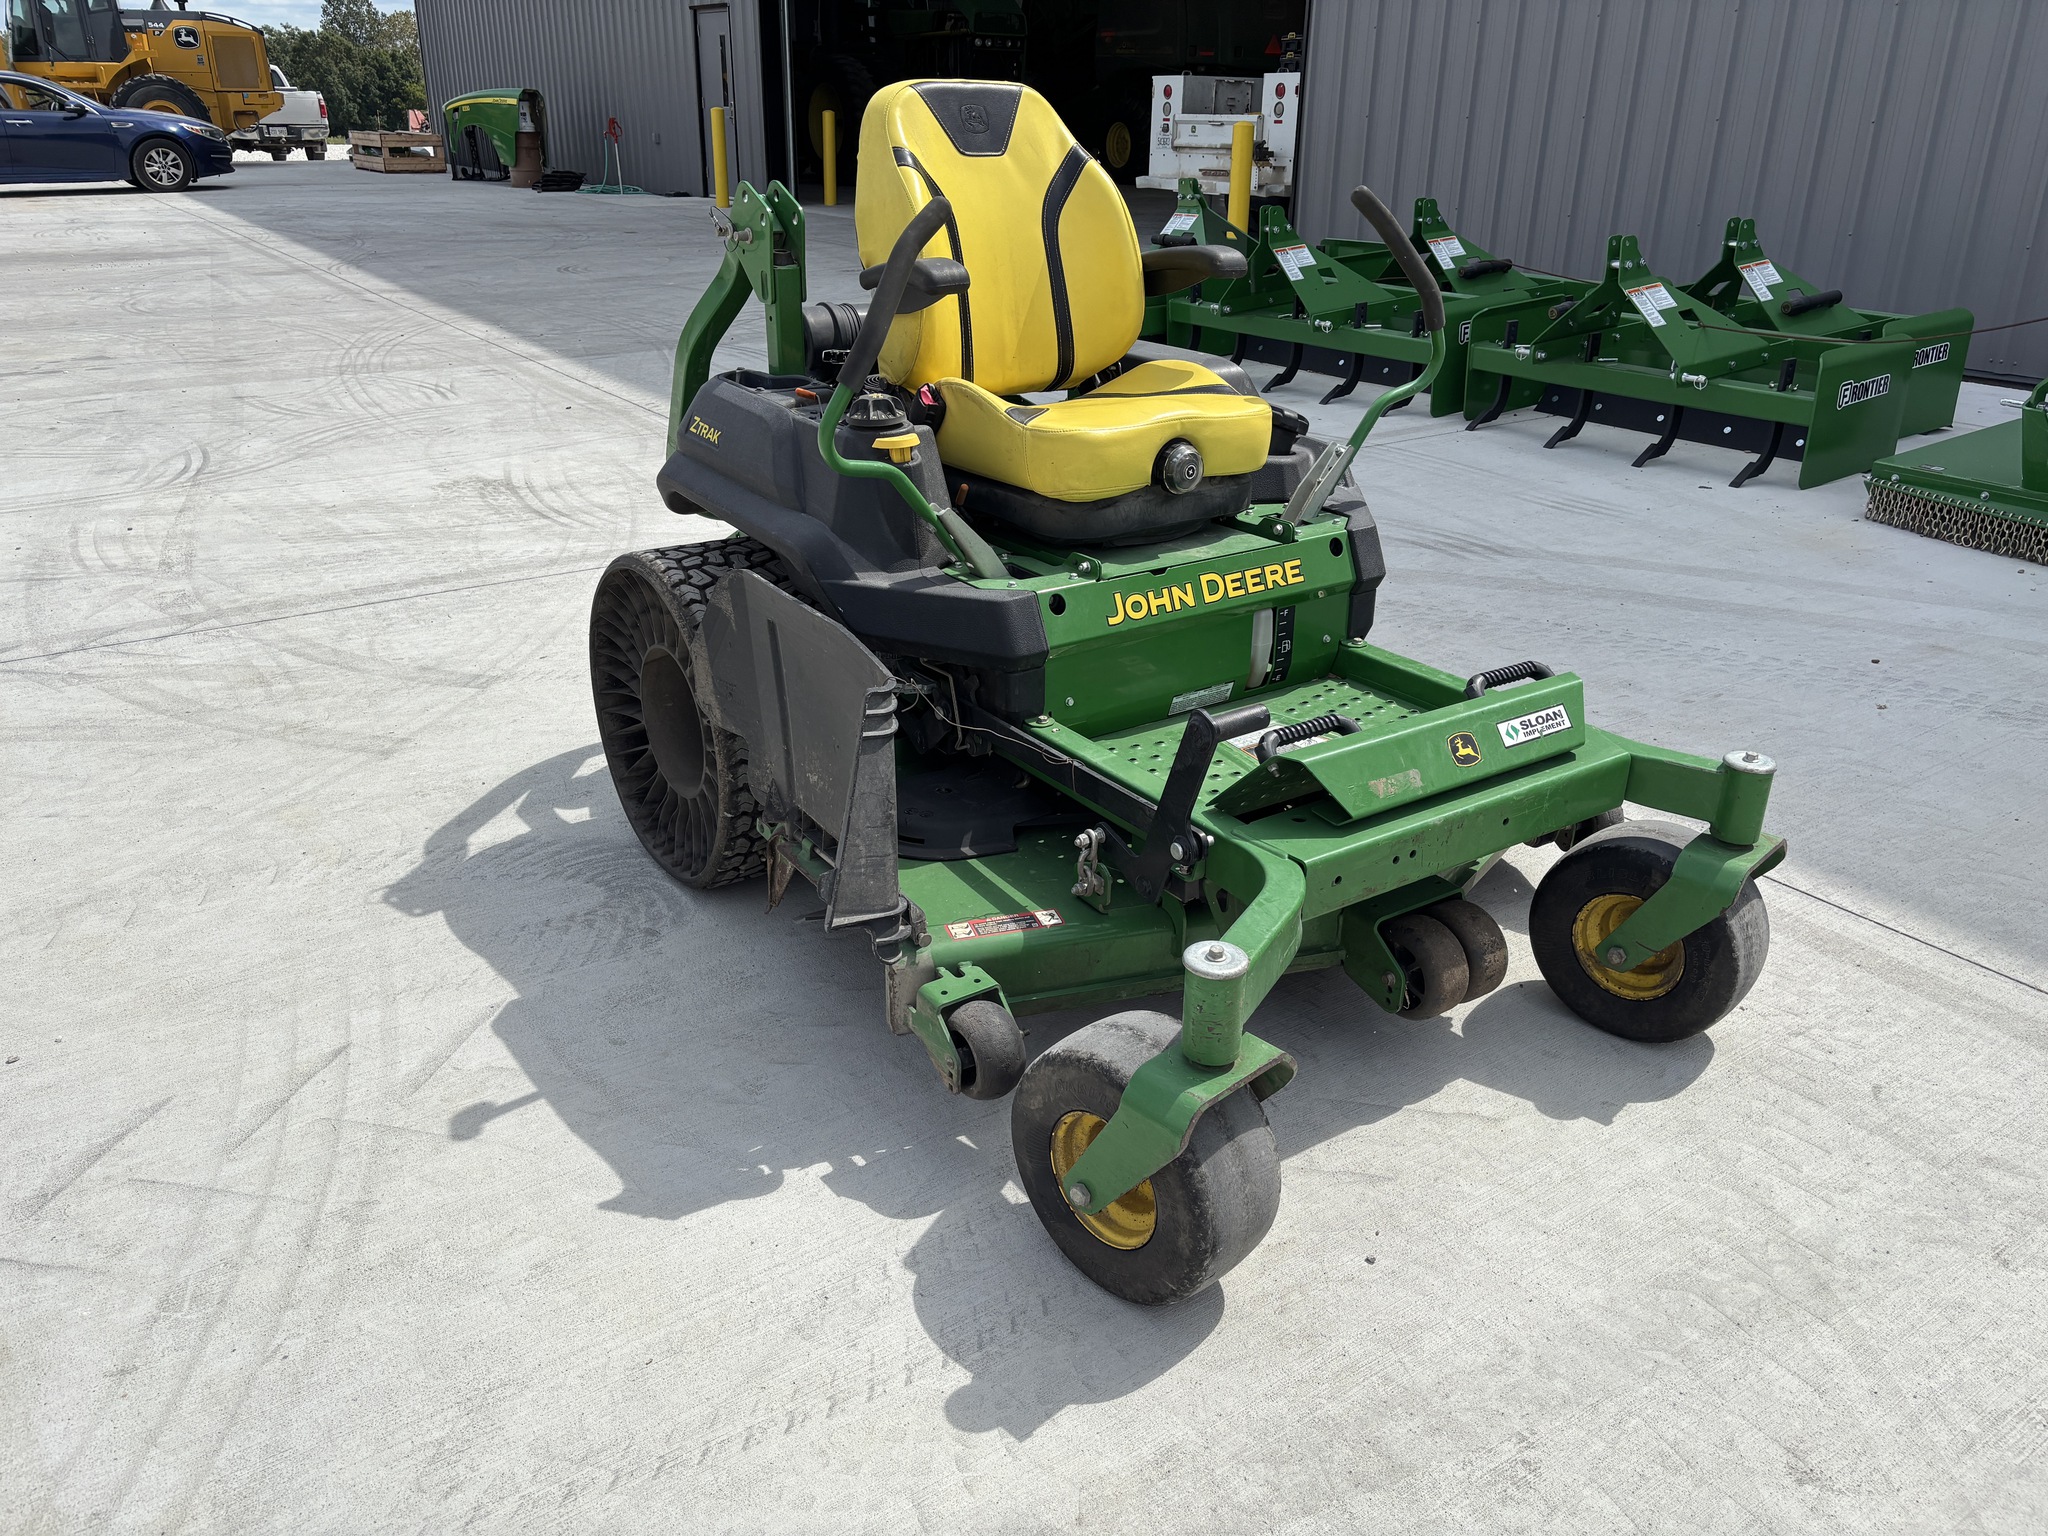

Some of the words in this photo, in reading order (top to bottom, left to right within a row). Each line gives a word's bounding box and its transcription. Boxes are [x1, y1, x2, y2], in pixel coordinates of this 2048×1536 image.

[1911, 343, 1950, 368] RONTIER
[1838, 374, 1890, 409] FRONTIER
[690, 415, 721, 445] ZTRAK
[1106, 582, 1197, 626] JOHN
[1199, 558, 1305, 604] DEERE
[1519, 709, 1564, 731] SLOAN
[1523, 719, 1566, 738] IMPLEMENT
